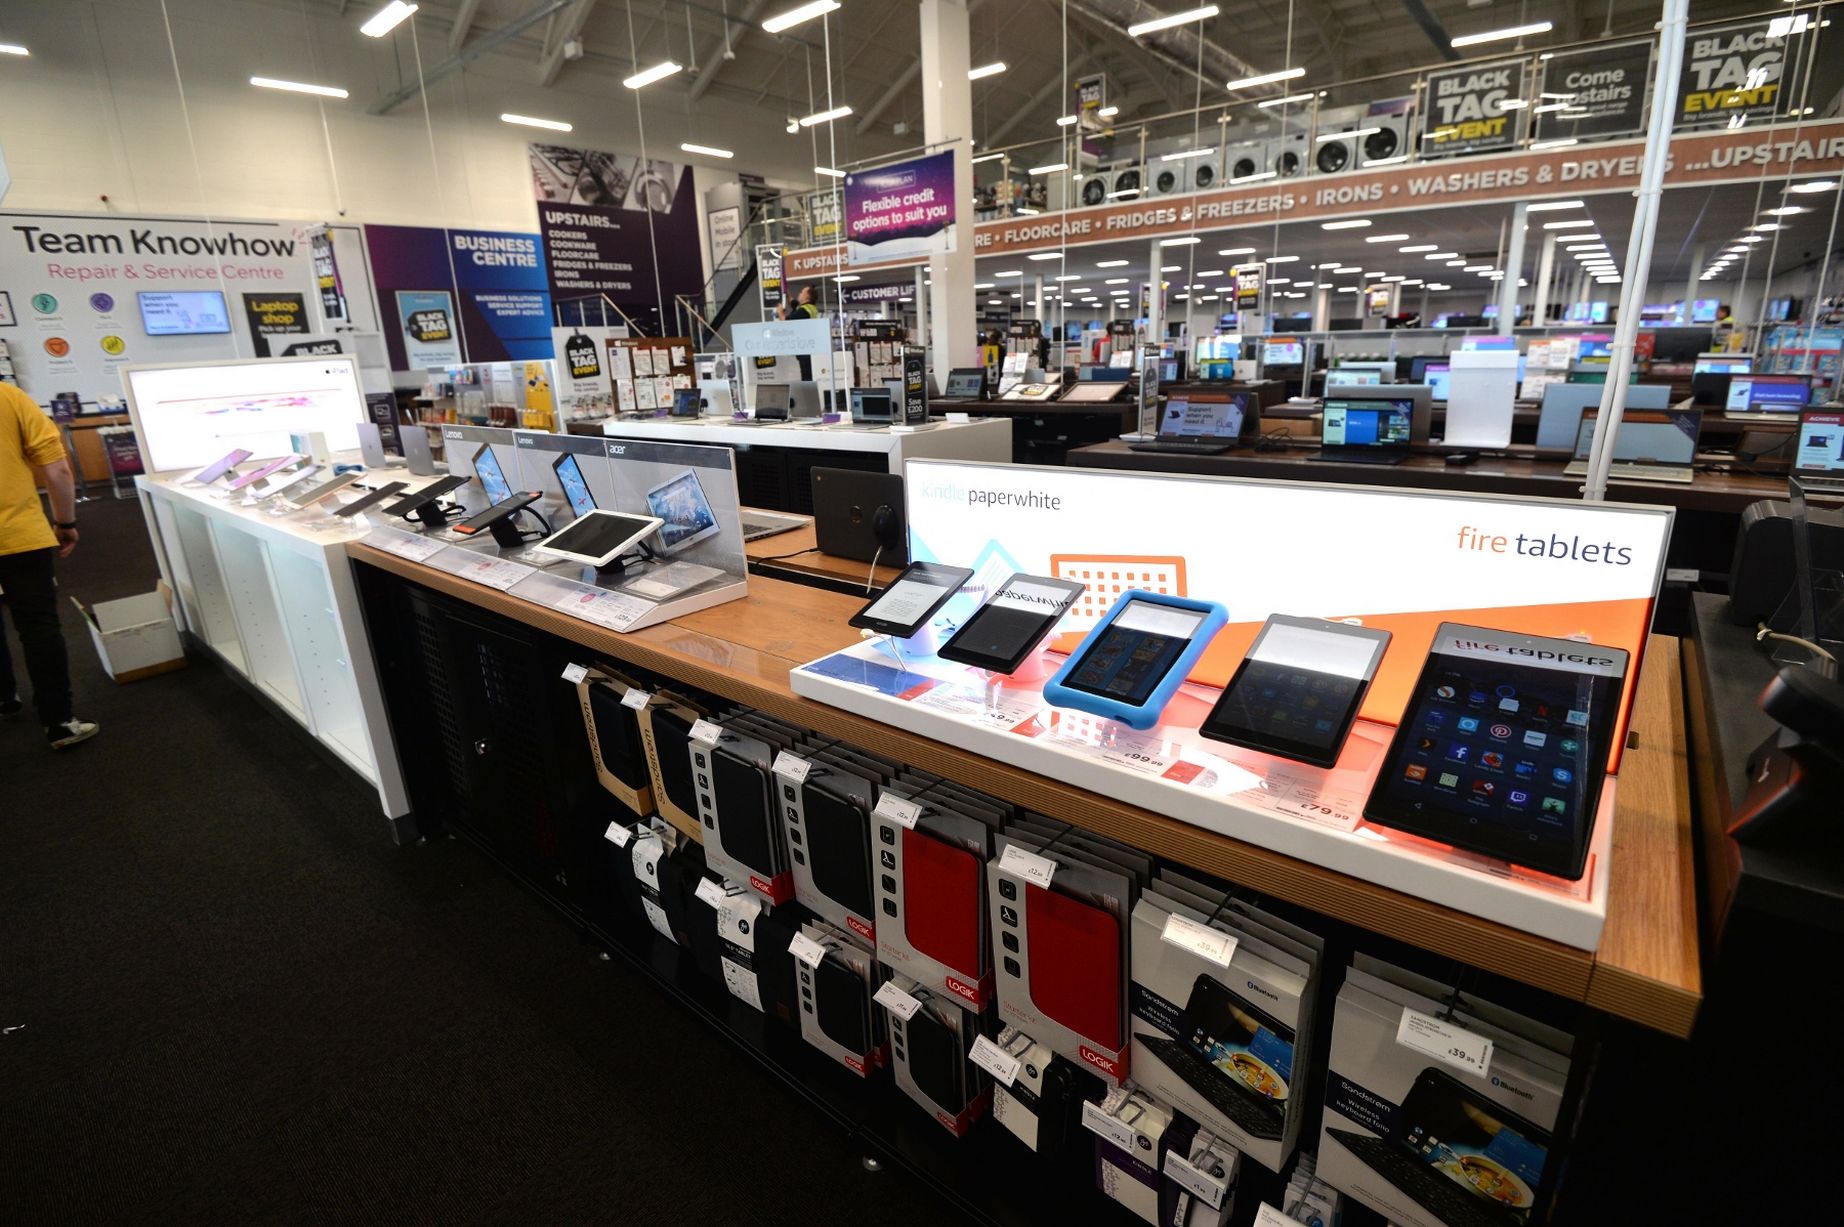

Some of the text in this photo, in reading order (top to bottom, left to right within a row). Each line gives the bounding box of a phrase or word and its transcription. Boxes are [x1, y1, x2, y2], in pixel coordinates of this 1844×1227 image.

[1692, 31, 1785, 59] BLACK
[1565, 69, 1625, 88] Come
[1690, 51, 1783, 91] TAG
[1437, 69, 1511, 97] BLACK
[1437, 89, 1509, 124] TAG
[1683, 84, 1778, 113] EVENT
[1433, 117, 1507, 143] EVENT
[811, 193, 841, 208] BLACK
[862, 188, 935, 214] Flexible credit
[1004, 220, 1092, 244] FLOORCARE
[1106, 209, 1176, 232] FRIDGES
[1180, 206, 1194, 222] &
[1197, 193, 1294, 220] FREEZERS
[1315, 183, 1383, 206] IRONS
[1407, 164, 1528, 197] WASHERS
[1536, 164, 1554, 182] &
[1561, 152, 1675, 181] DRYES
[545, 211, 621, 229] UPSTAIRS...
[813, 205, 842, 224] TAG
[853, 205, 947, 233] options to suit you
[548, 230, 588, 240] COOKERS
[813, 222, 842, 237] EVENT
[12, 226, 295, 257] Team Knowhow
[454, 235, 535, 253] BUSINESS
[550, 240, 597, 250] COOKWARE
[472, 251, 538, 268] CENTRE
[551, 250, 600, 260] FLOORCARE
[762, 259, 780, 267] BLACK
[47, 263, 285, 282] Repair & Service Centre
[553, 260, 588, 270] FRIDGES
[595, 262, 633, 272] FREEZERS
[554, 270, 580, 279] IRONS
[762, 267, 781, 280] TAG
[555, 280, 595, 289] WASHERS
[602, 281, 632, 290] DRYERS
[851, 286, 899, 301] CUSTOMER
[1238, 280, 1260, 290] TAG
[252, 300, 300, 312] Laptop
[475, 294, 507, 302] BUSINESS
[261, 313, 294, 324] shop
[415, 312, 445, 321] BLACK
[418, 320, 447, 332] TAG
[420, 331, 449, 340] EVENT
[568, 347, 595, 358] BLACK
[570, 355, 597, 368] TAG
[572, 365, 599, 376] EVENT
[908, 376, 922, 385] TAG
[907, 405, 923, 413] £200
[908, 398, 922, 406] Save
[444, 430, 463, 440] Lenovo
[609, 445, 626, 455] acer
[921, 481, 1061, 511] kindle paperwhite
[1457, 525, 1633, 566] fire tablets
[1124, 751, 1164, 768] £99.99
[1300, 803, 1349, 822] £79.99
[751, 876, 771, 895] LOGIK
[848, 918, 870, 938] LOGIK
[947, 977, 975, 1000] LOGIK
[845, 1055, 864, 1071] LOGIK
[1081, 1047, 1114, 1073] LOGIK
[1447, 1047, 1476, 1064] £39.99
[1499, 1080, 1536, 1101] Bluetooth
[1336, 1099, 1390, 1133] keyboard folio
[1347, 1098, 1380, 1120] Wireless
